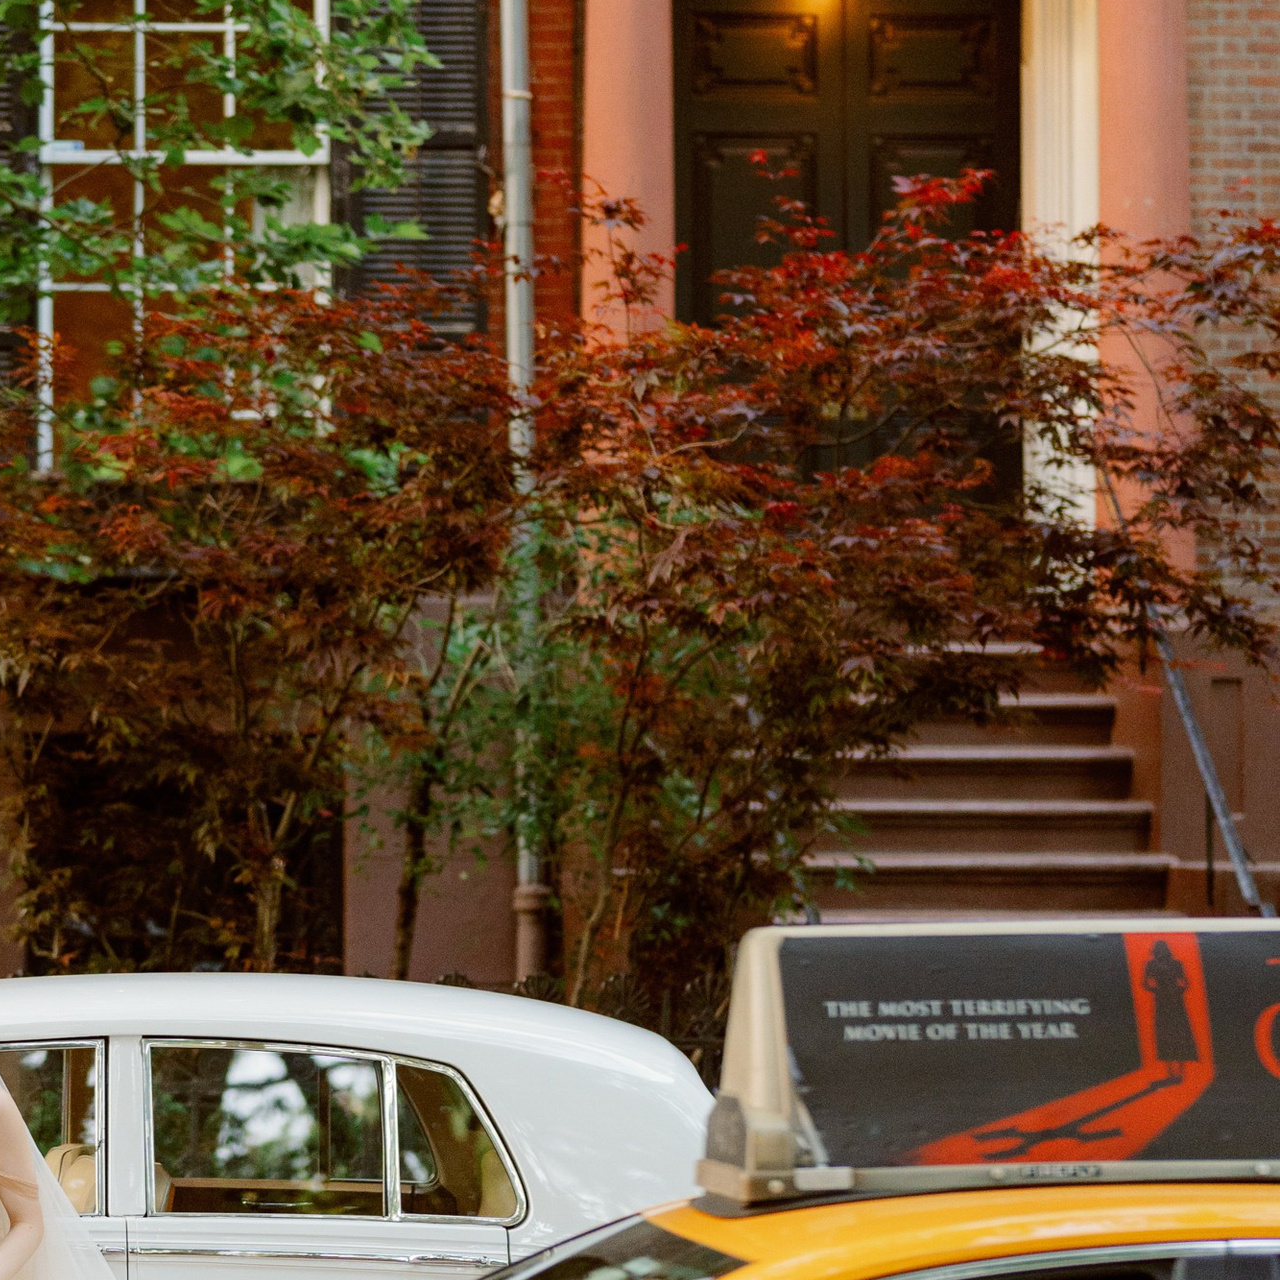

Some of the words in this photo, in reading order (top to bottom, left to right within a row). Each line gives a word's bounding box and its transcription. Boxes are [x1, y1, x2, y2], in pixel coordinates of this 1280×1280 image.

[825, 1001, 872, 1018] THE
[878, 1000, 943, 1017] MOST
[949, 998, 1091, 1016] TERRIFYING
[844, 1023, 922, 1040] MOVIE
[925, 1023, 959, 1040] OF
[963, 1022, 1012, 1040] THE
[1016, 1022, 1079, 1039] YEAR
